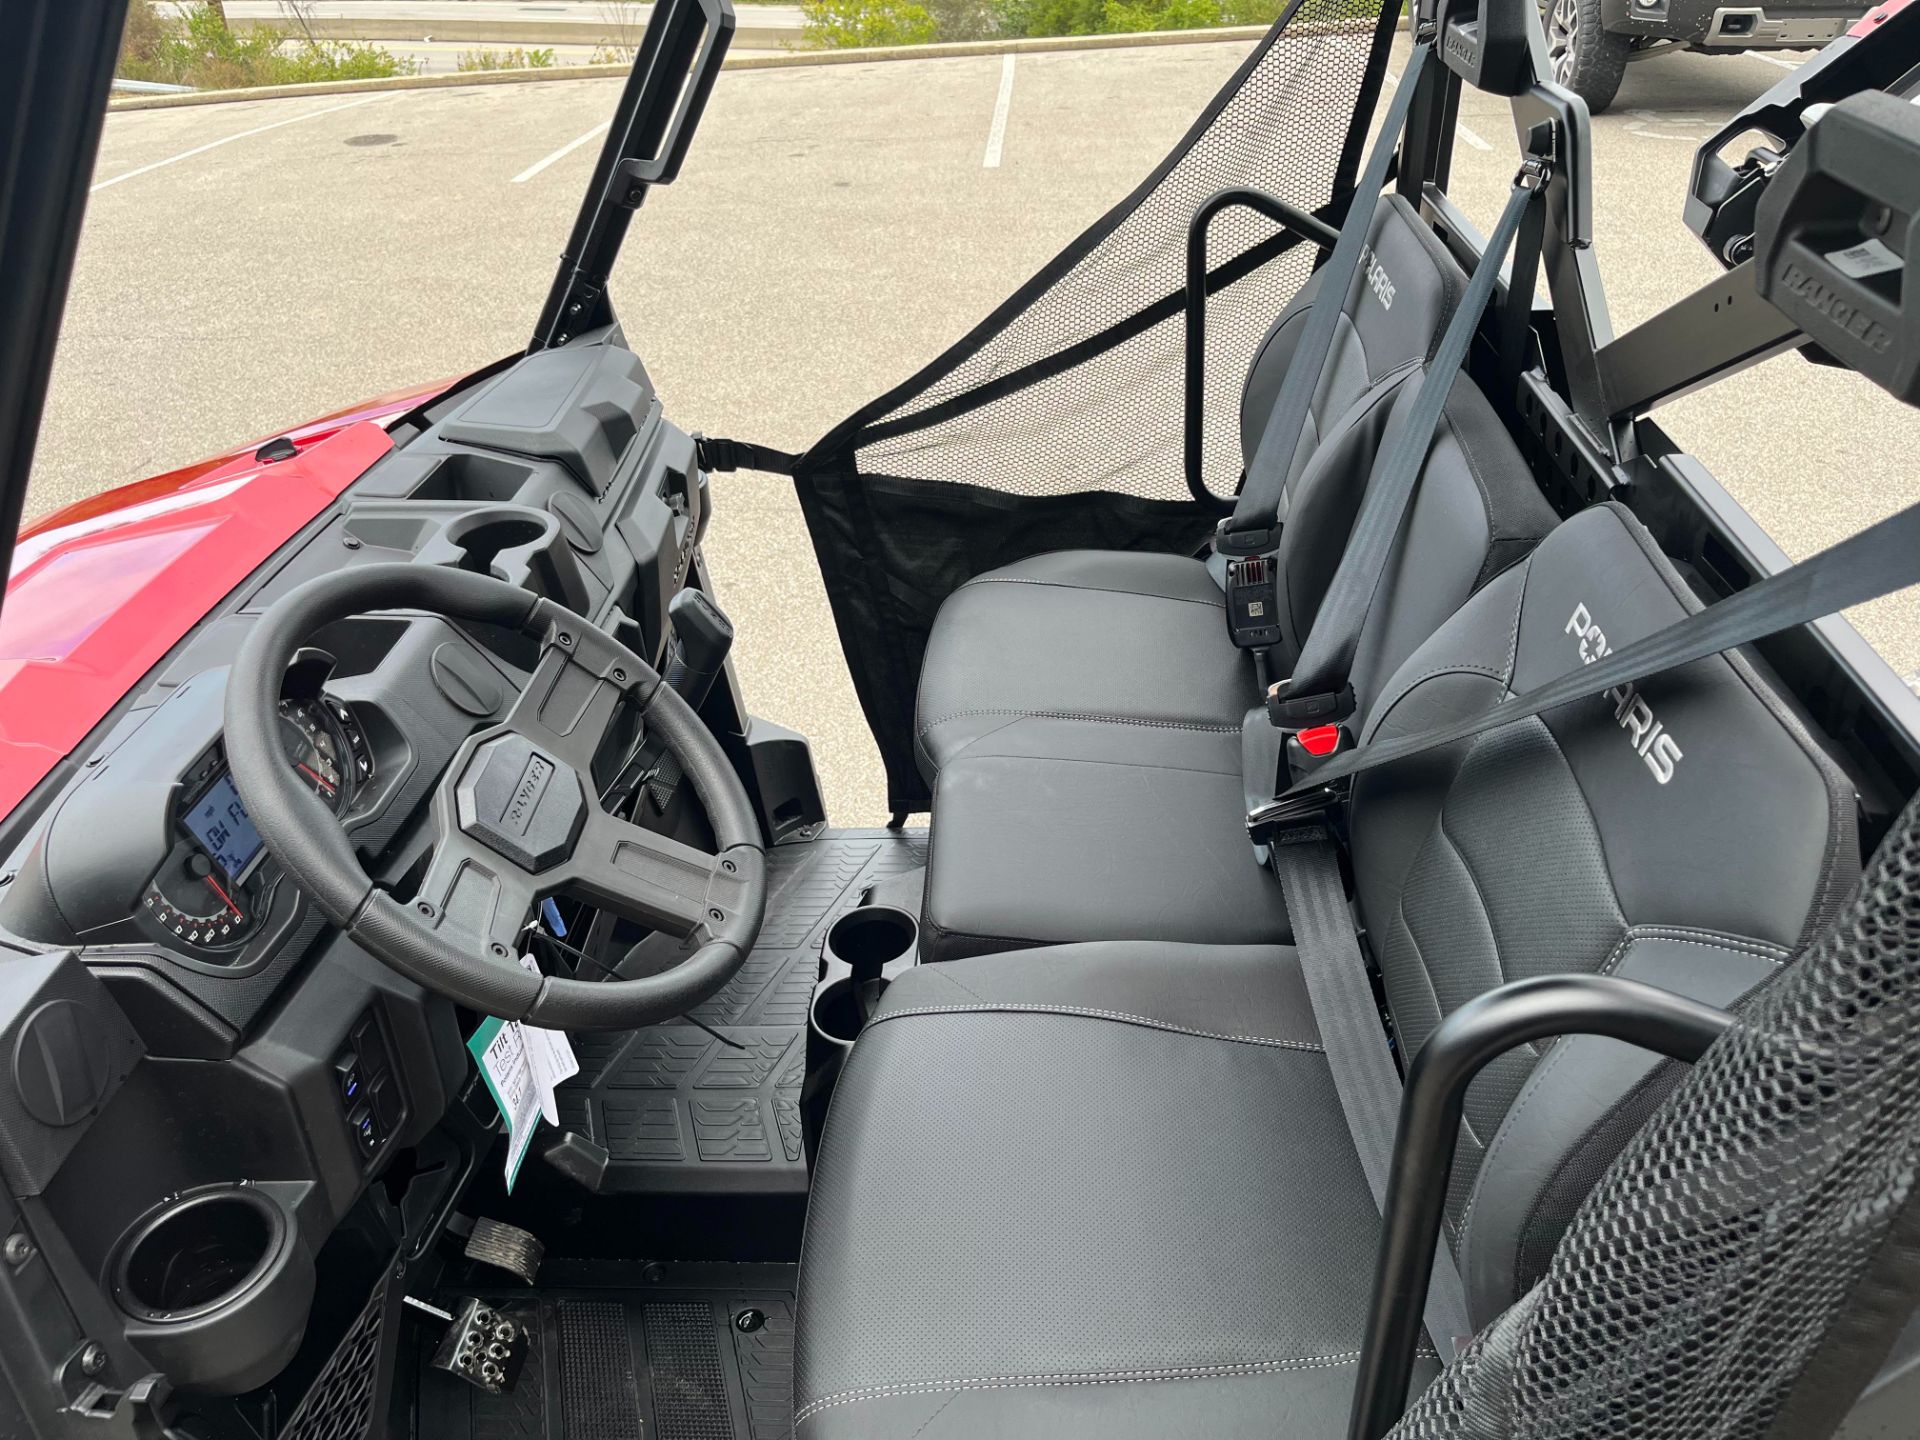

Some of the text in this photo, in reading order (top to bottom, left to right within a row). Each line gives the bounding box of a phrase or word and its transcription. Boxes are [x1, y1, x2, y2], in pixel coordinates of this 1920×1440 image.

[1359, 243, 1396, 311] POLARIS
[1780, 262, 1894, 354] RANGER
[1565, 602, 1684, 785] POARIS
[490, 1033, 509, 1060] Tilt
